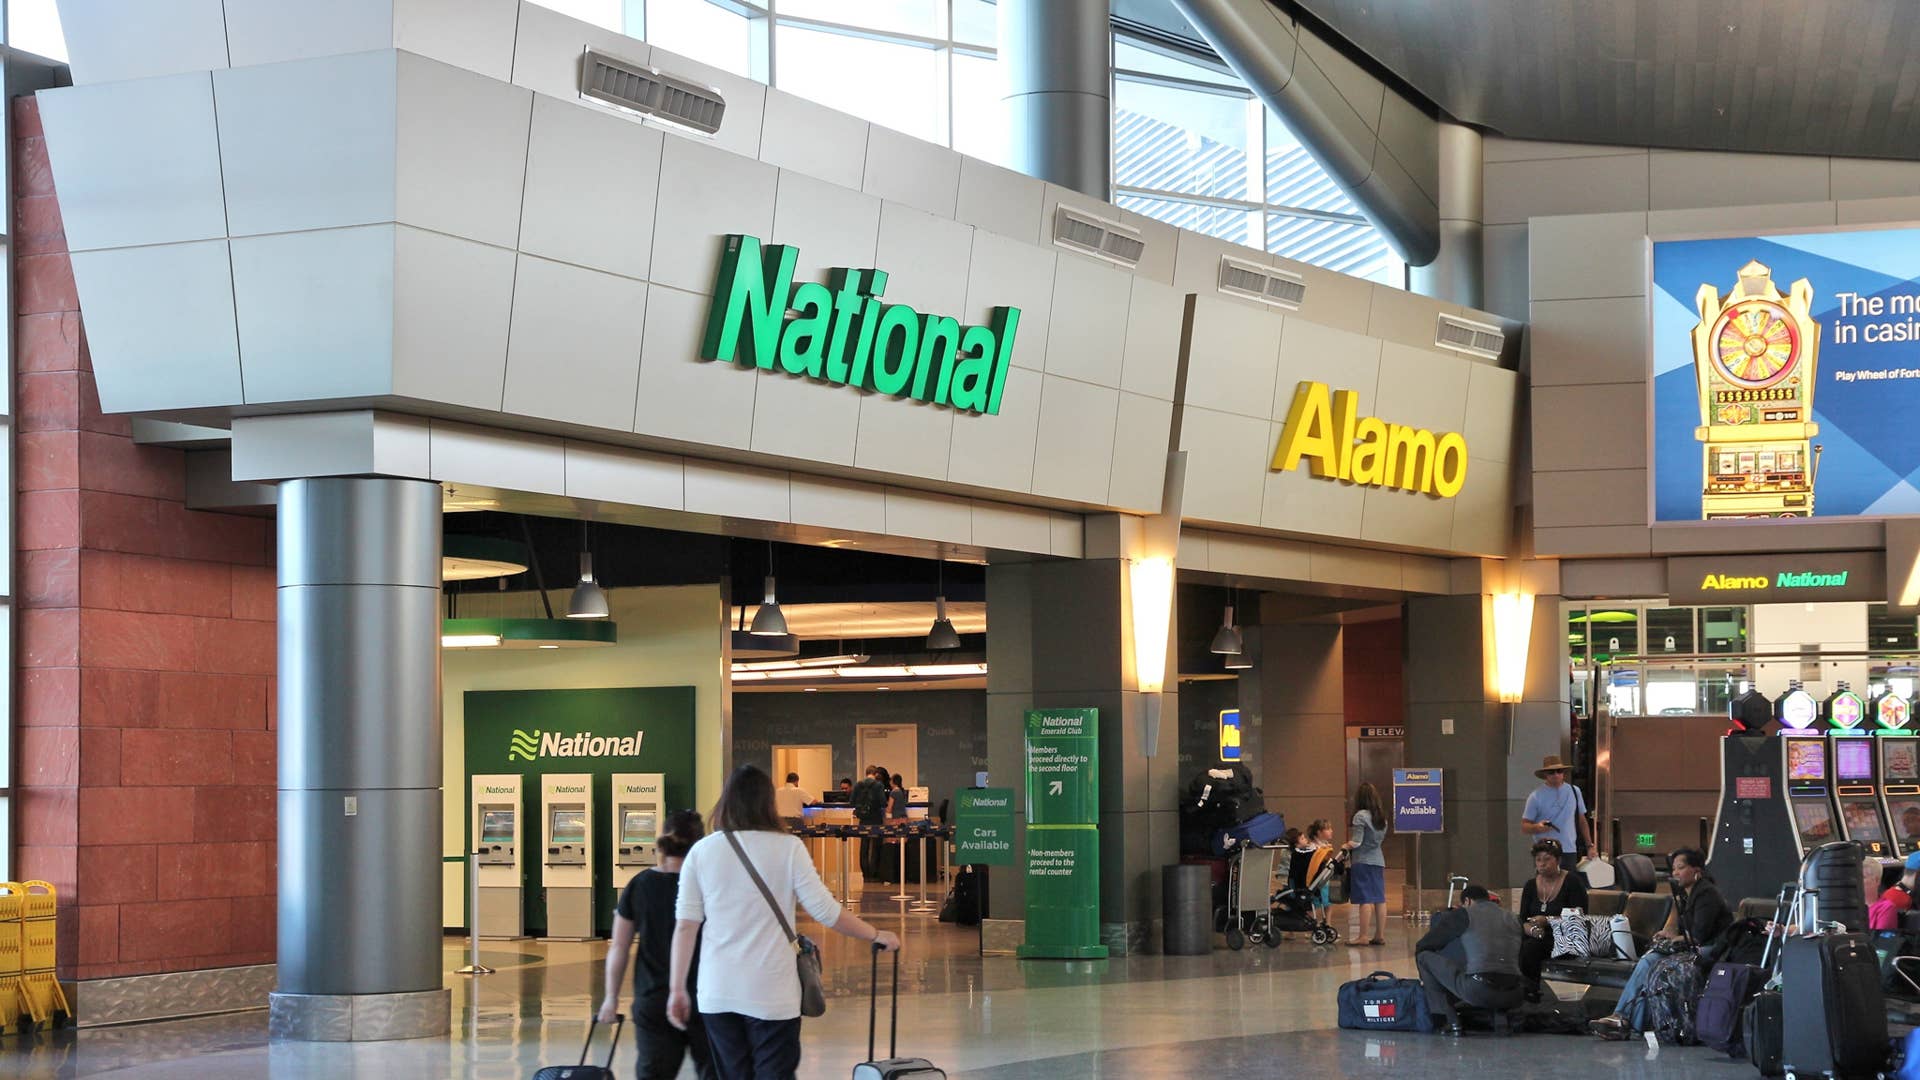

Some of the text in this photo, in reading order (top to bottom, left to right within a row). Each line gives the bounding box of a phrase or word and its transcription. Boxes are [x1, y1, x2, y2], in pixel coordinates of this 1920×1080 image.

[1835, 292, 1884, 316] The
[702, 234, 1021, 416] National
[1835, 320, 1857, 344] in
[1835, 371, 1856, 382] Play
[1857, 369, 1887, 380] Wheel
[1888, 369, 1899, 379] of
[1272, 381, 1467, 498] Alamo
[1701, 571, 1848, 590] Alamo National
[1042, 716, 1083, 727] National
[1067, 727, 1082, 735] Club
[540, 731, 644, 757] National
[1054, 755, 1079, 764] directly
[1039, 764, 1060, 772] second
[1061, 764, 1078, 772] floor
[485, 785, 515, 794] National
[555, 785, 586, 793] National
[626, 785, 657, 793] National
[972, 798, 1007, 807] National
[1409, 796, 1427, 805] Cars
[1400, 806, 1437, 815] Available
[973, 828, 997, 837] Cars
[961, 841, 1009, 850] Available
[1031, 849, 1074, 857] Non-members
[1030, 858, 1054, 867] proceed
[1063, 858, 1075, 866] the
